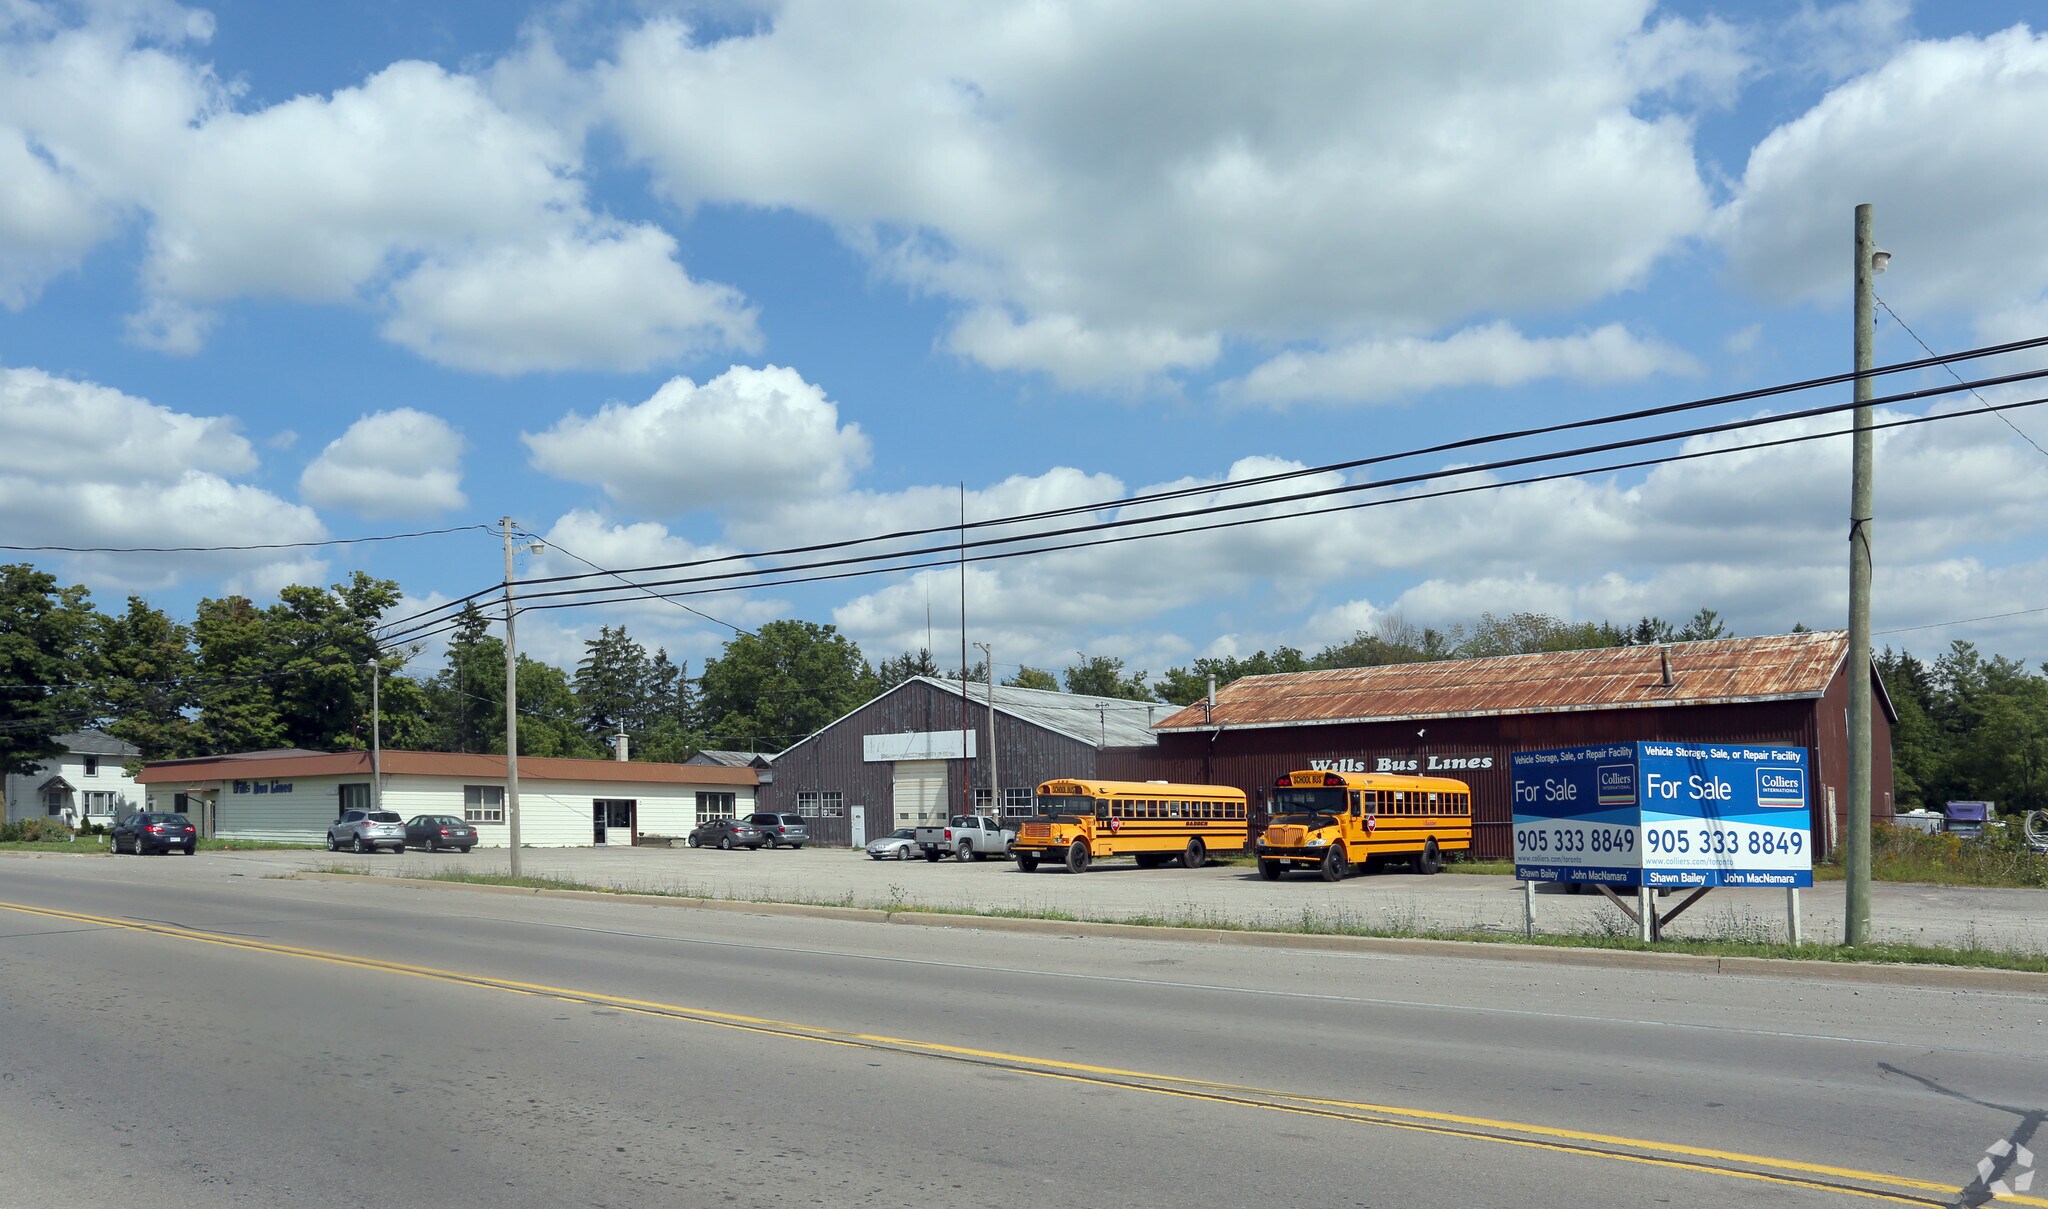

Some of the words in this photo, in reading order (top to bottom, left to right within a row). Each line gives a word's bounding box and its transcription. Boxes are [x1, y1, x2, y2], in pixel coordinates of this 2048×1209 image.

[1514, 755, 1534, 765] Vehicle
[1535, 754, 1559, 764] Storage,
[1560, 752, 1576, 762] Sale,
[1577, 752, 1584, 760] or
[1586, 749, 1606, 761] Repair
[1608, 746, 1633, 758] Facility
[1644, 746, 1674, 757] Vehicle
[1675, 747, 1708, 760] Storage,
[1710, 749, 1730, 761] Sale,
[1743, 750, 1768, 761] Repair
[1771, 751, 1801, 763] Facility
[1310, 759, 1365, 772] Wills
[1376, 757, 1418, 772] Bus
[1427, 756, 1493, 770] Lines
[1293, 775, 1311, 784] SCHOOL
[1312, 775, 1322, 783] BUS
[1601, 773, 1631, 785] Colliers
[1761, 775, 1799, 788] Colliers
[1052, 785, 1066, 793] SCHOOL
[1515, 780, 1540, 802] For
[1544, 778, 1577, 801] Sale
[1647, 773, 1682, 799] For
[1688, 775, 1732, 800] Sale
[1517, 830, 1548, 851] 905
[1554, 829, 1584, 851] 333
[1591, 829, 1634, 852] 8849
[1647, 829, 1690, 853] 905
[1699, 830, 1739, 853] 333
[1748, 831, 1803, 855] 8849
[1518, 855, 1582, 864] www.colliers.com/toronto
[1645, 857, 1734, 867] www.colliers.com/toronto
[1520, 868, 1540, 877] Shawn
[1571, 870, 1588, 880] John
[1588, 870, 1627, 882] MacNamara
[1650, 872, 1679, 883] Shawn
[1680, 872, 1706, 885] Bailey
[1723, 873, 1745, 883] John
[1747, 873, 1795, 884] MacNamara
